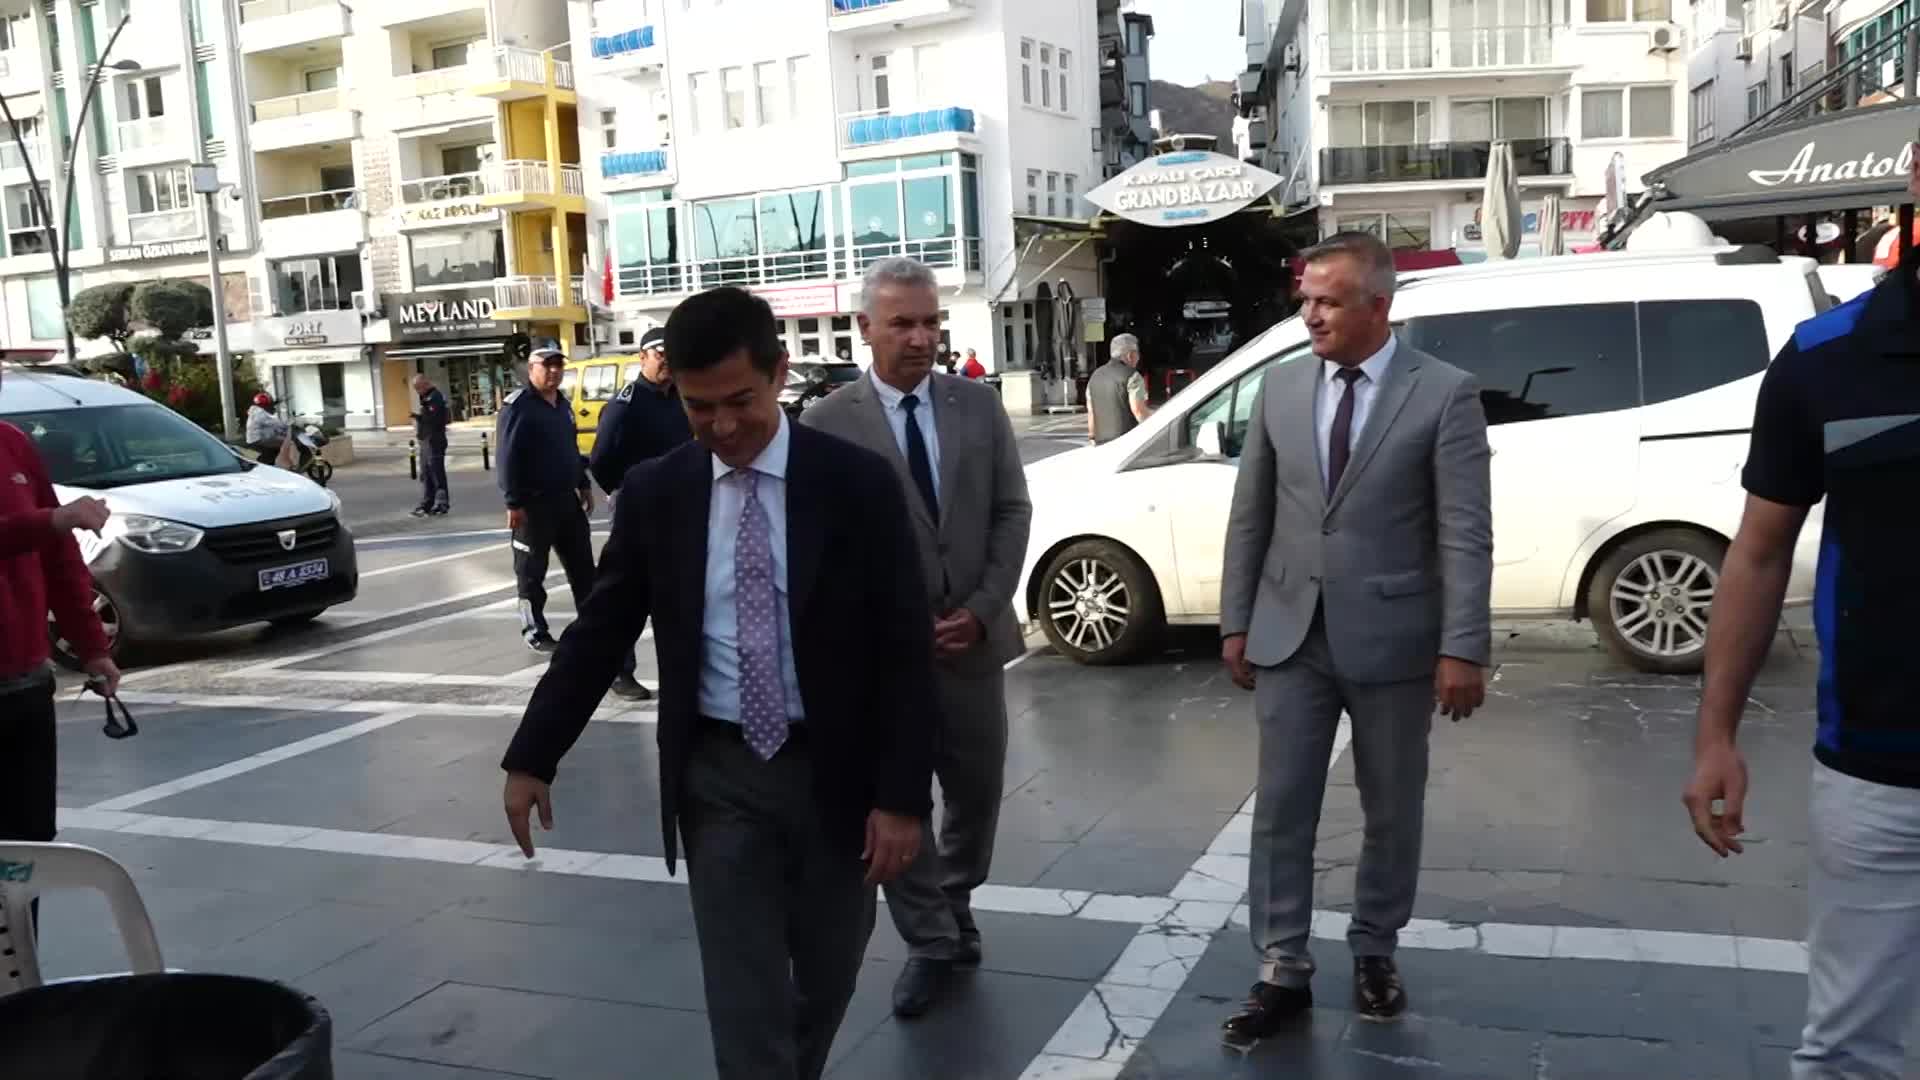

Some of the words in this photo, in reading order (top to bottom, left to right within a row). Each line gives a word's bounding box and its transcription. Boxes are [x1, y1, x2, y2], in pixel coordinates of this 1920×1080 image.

[1114, 187, 1179, 210] GRAND
[1180, 181, 1256, 205] BAZAAR
[400, 298, 494, 324] MEYLAND
